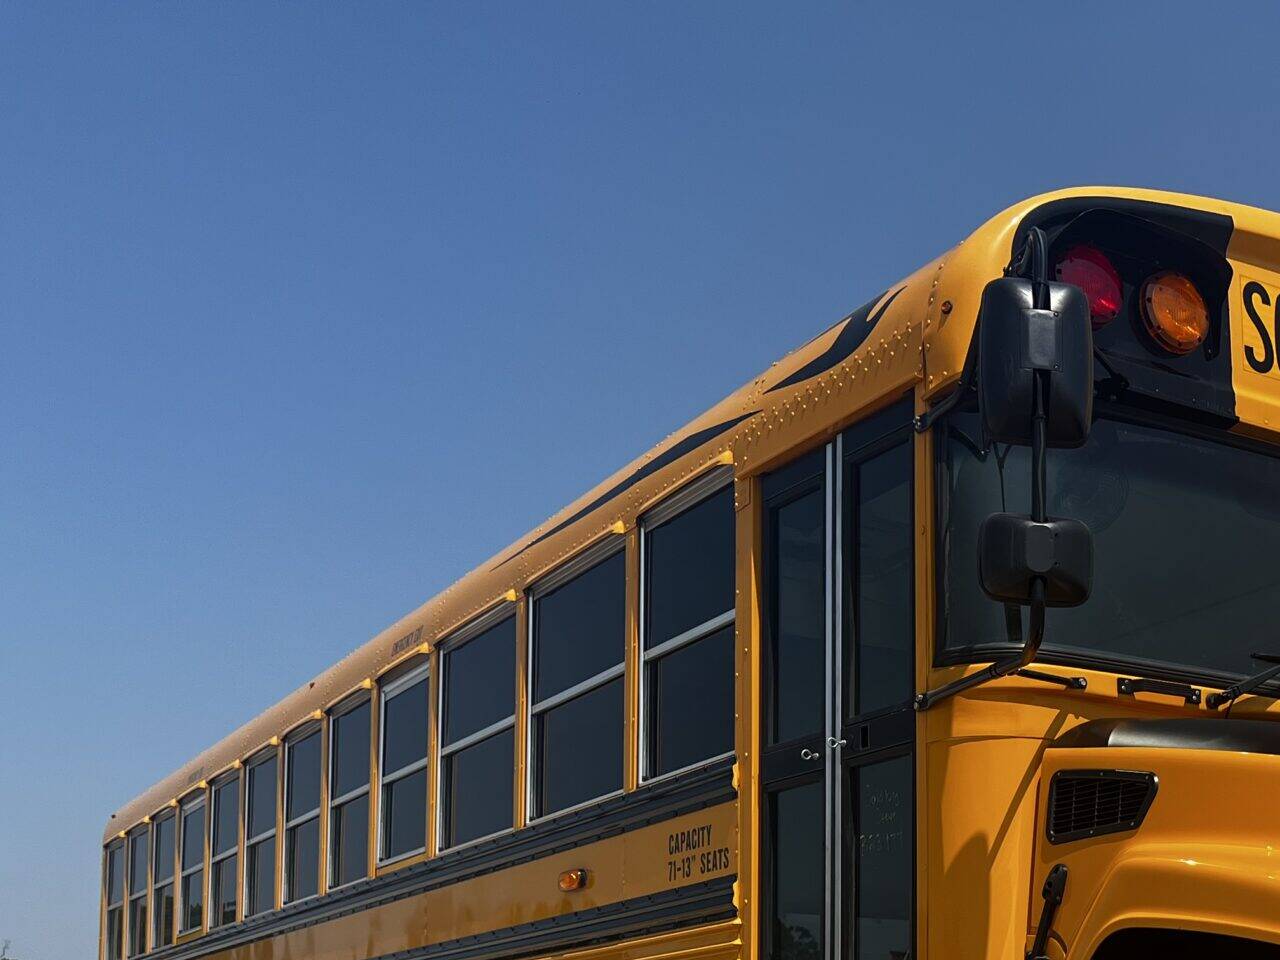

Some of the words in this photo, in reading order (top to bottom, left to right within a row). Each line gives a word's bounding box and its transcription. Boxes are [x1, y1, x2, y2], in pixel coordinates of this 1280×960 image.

[668, 824, 712, 856] CAPACITY
[668, 854, 695, 882] 71-13"
[700, 847, 729, 874] SEATS
